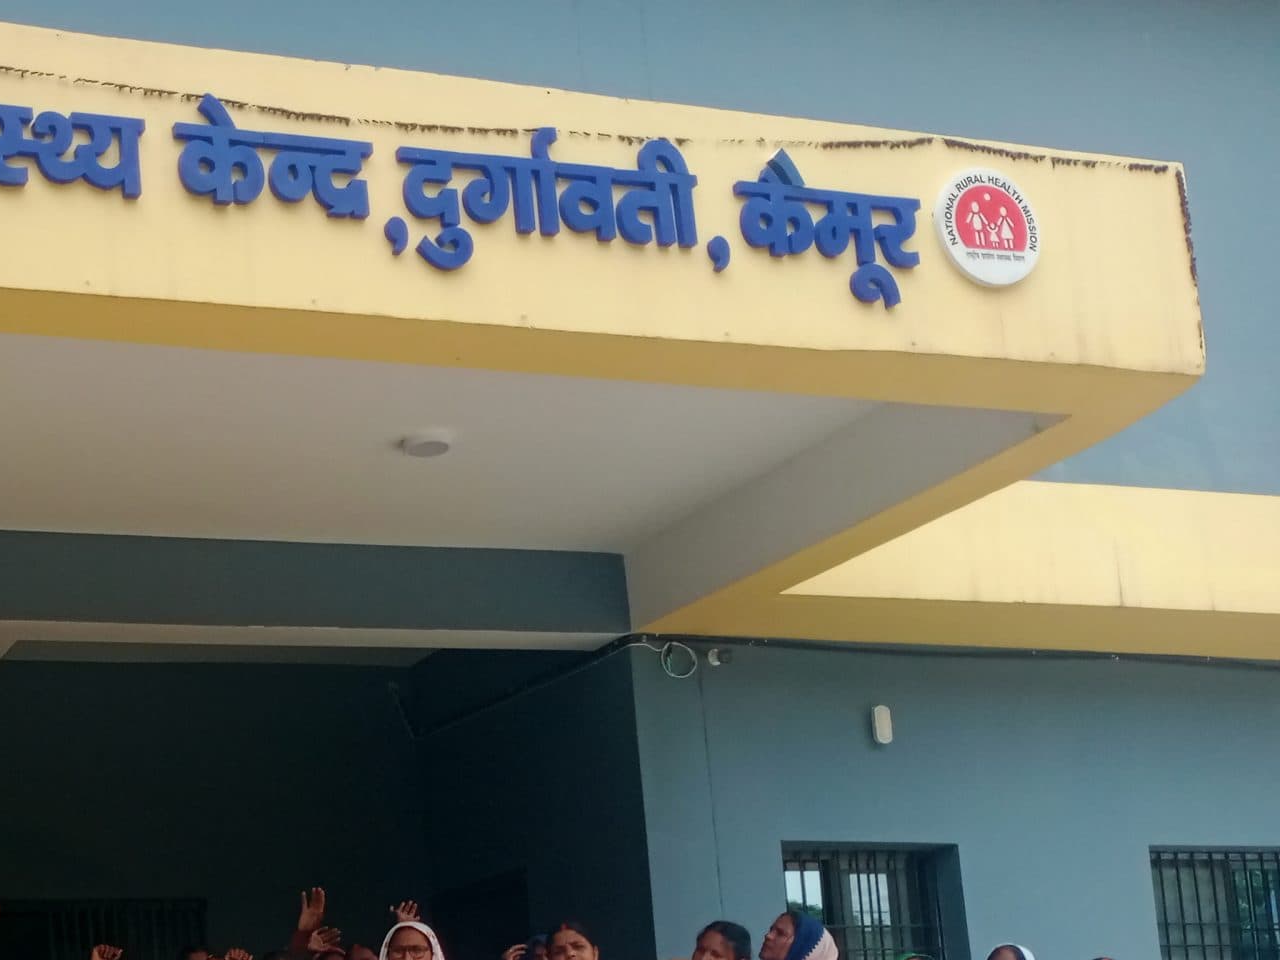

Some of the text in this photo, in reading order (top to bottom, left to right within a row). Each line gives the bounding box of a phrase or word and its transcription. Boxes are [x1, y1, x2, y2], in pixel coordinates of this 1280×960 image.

[733, 148, 921, 310] कैमूर
[944, 174, 1037, 252] NATIONAL RURAL HEALTH MISSION
